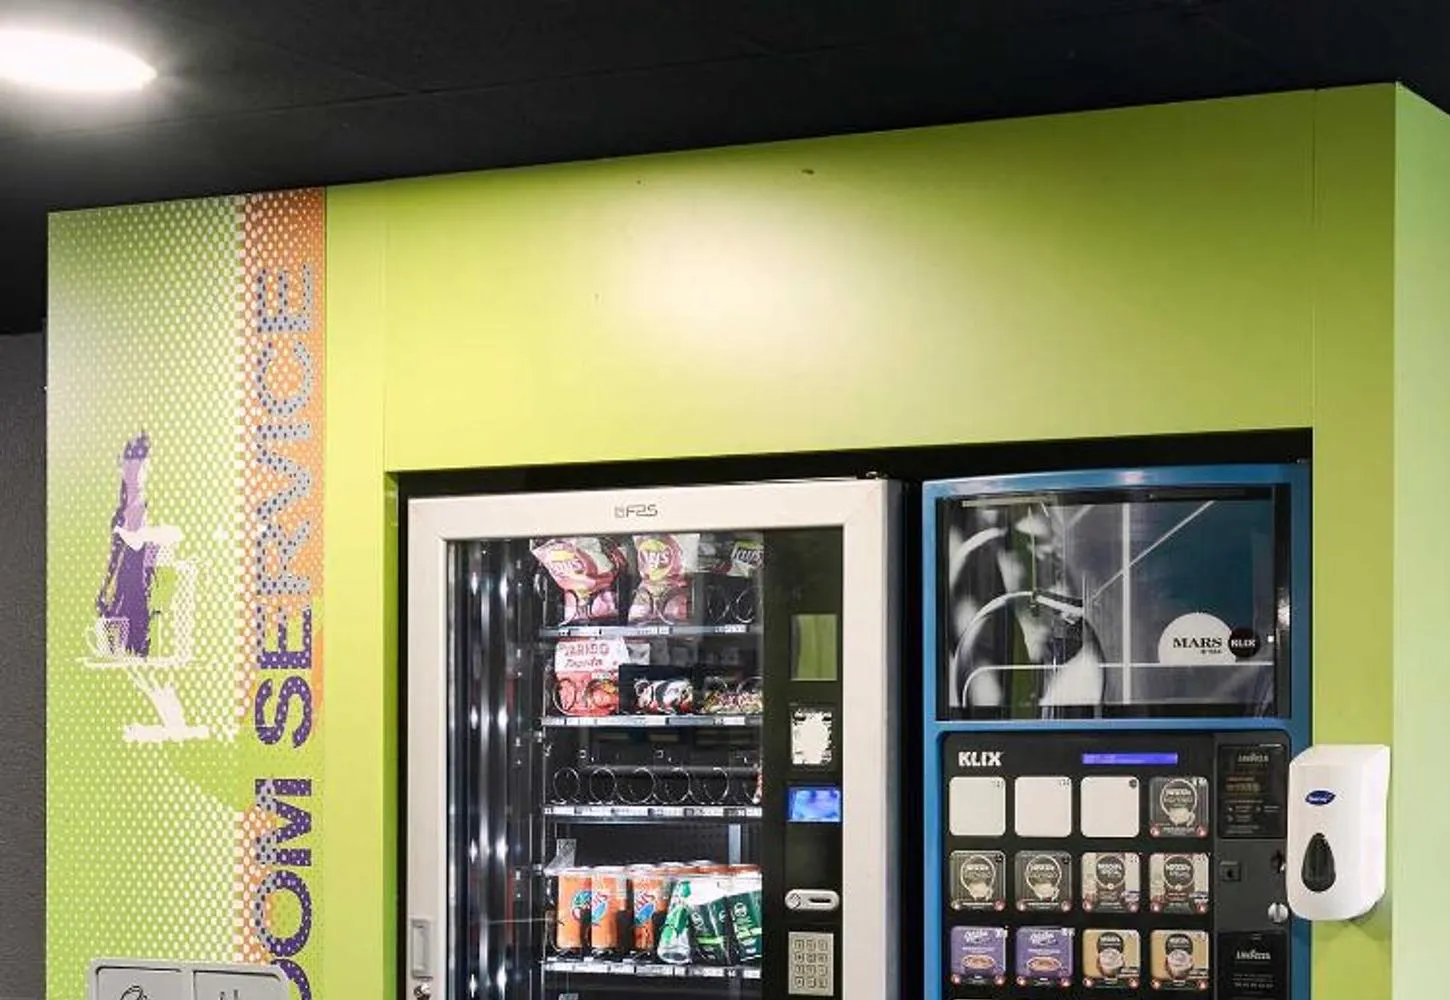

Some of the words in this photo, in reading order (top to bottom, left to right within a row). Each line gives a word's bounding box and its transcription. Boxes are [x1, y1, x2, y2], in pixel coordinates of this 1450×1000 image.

[255, 263, 313, 749] SERVICE
[1173, 637, 1222, 648] MARS
[1231, 639, 1256, 648] KLIX
[958, 751, 1002, 767] KLIX
